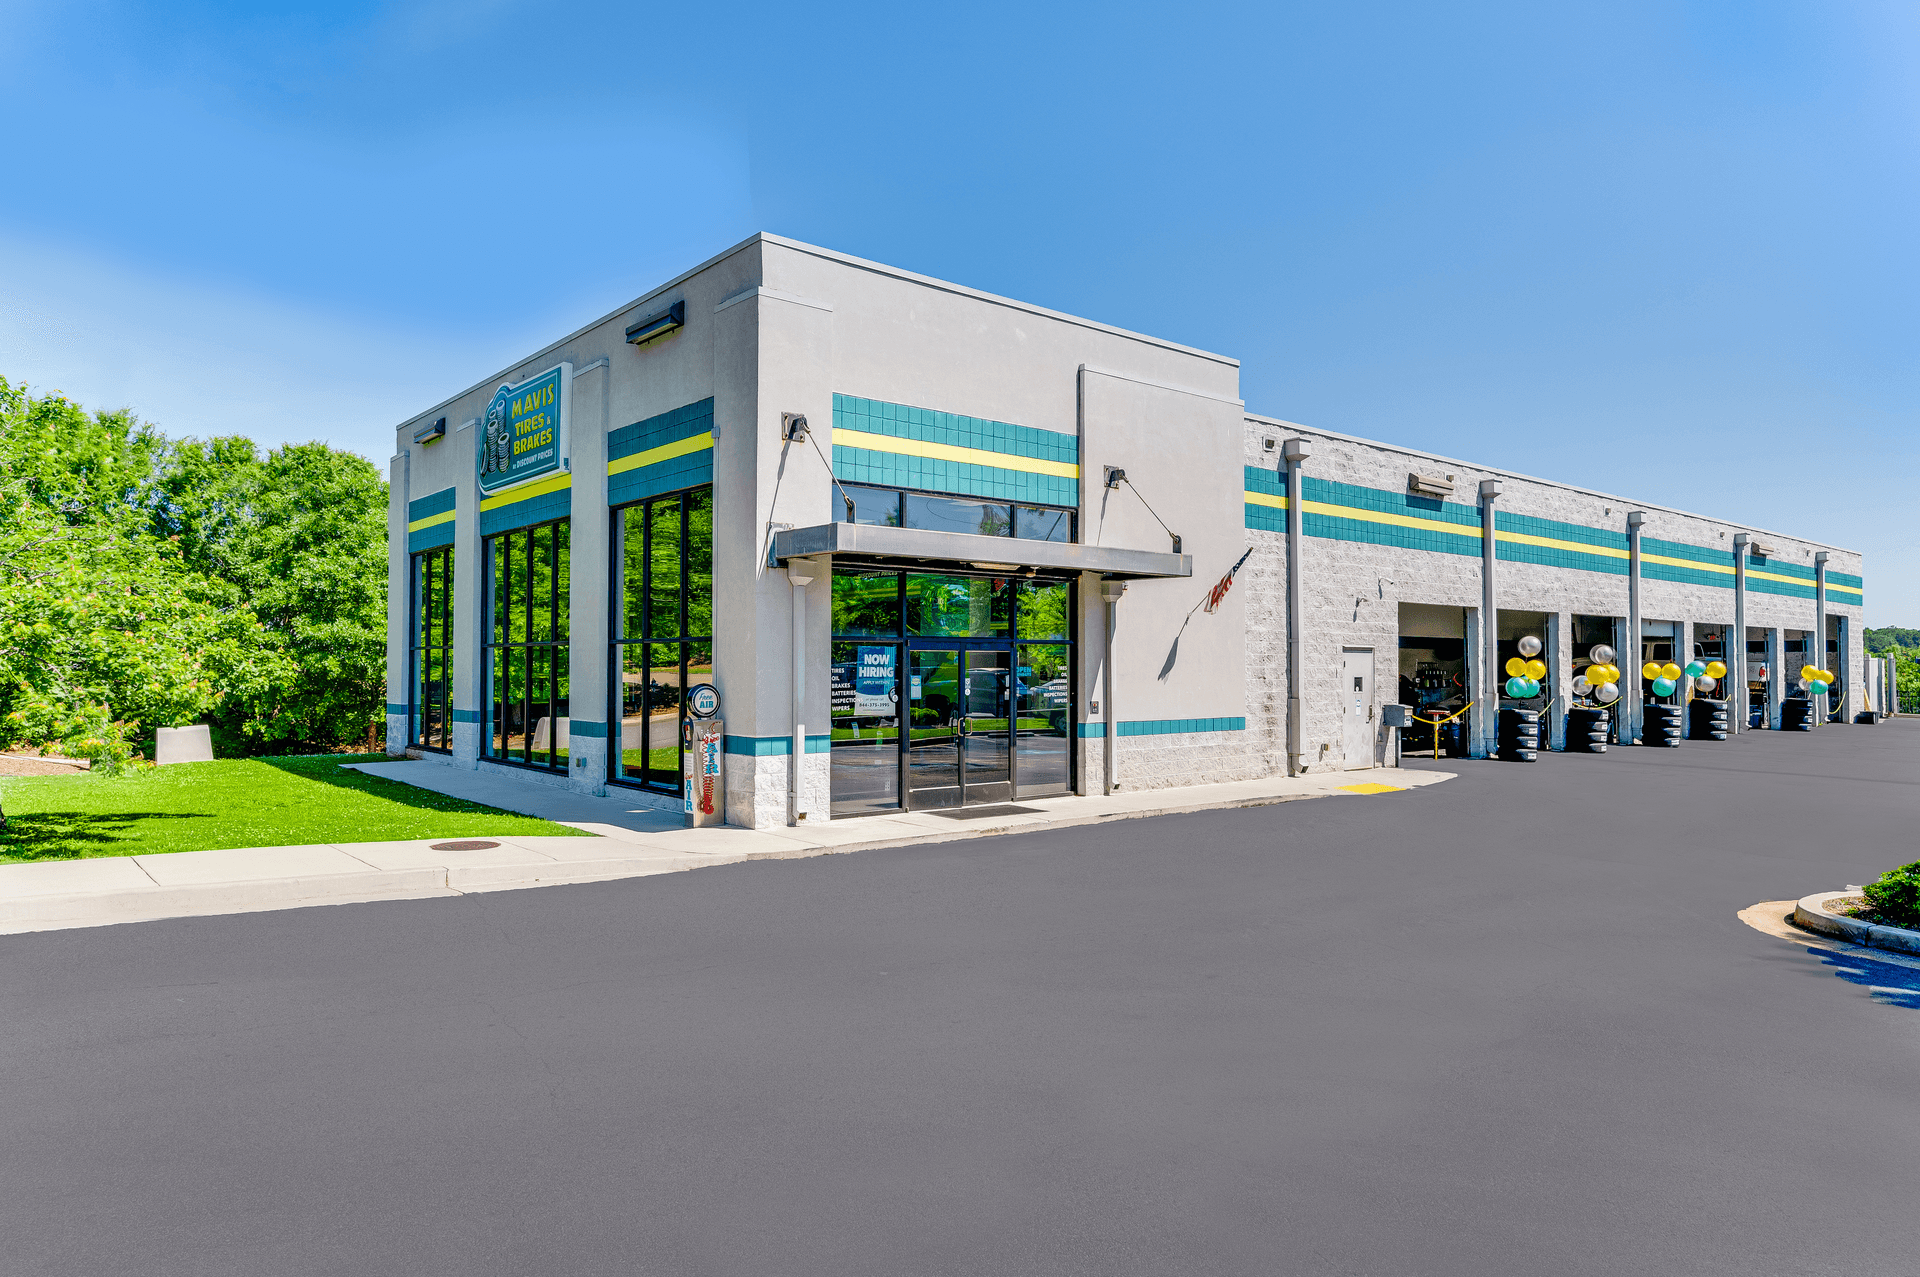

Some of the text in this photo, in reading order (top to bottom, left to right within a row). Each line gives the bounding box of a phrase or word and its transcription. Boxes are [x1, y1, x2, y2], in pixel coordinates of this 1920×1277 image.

[511, 383, 554, 419] MAVIS
[515, 412, 545, 437] TIRES
[513, 427, 553, 456] BRAKES
[517, 454, 537, 468] DISCOUNT
[537, 448, 553, 461] PRICES
[864, 654, 890, 665] NOW
[858, 666, 894, 678] HIRING
[698, 691, 714, 701] Free
[699, 700, 714, 709] AIR
[685, 779, 693, 812] AIR
